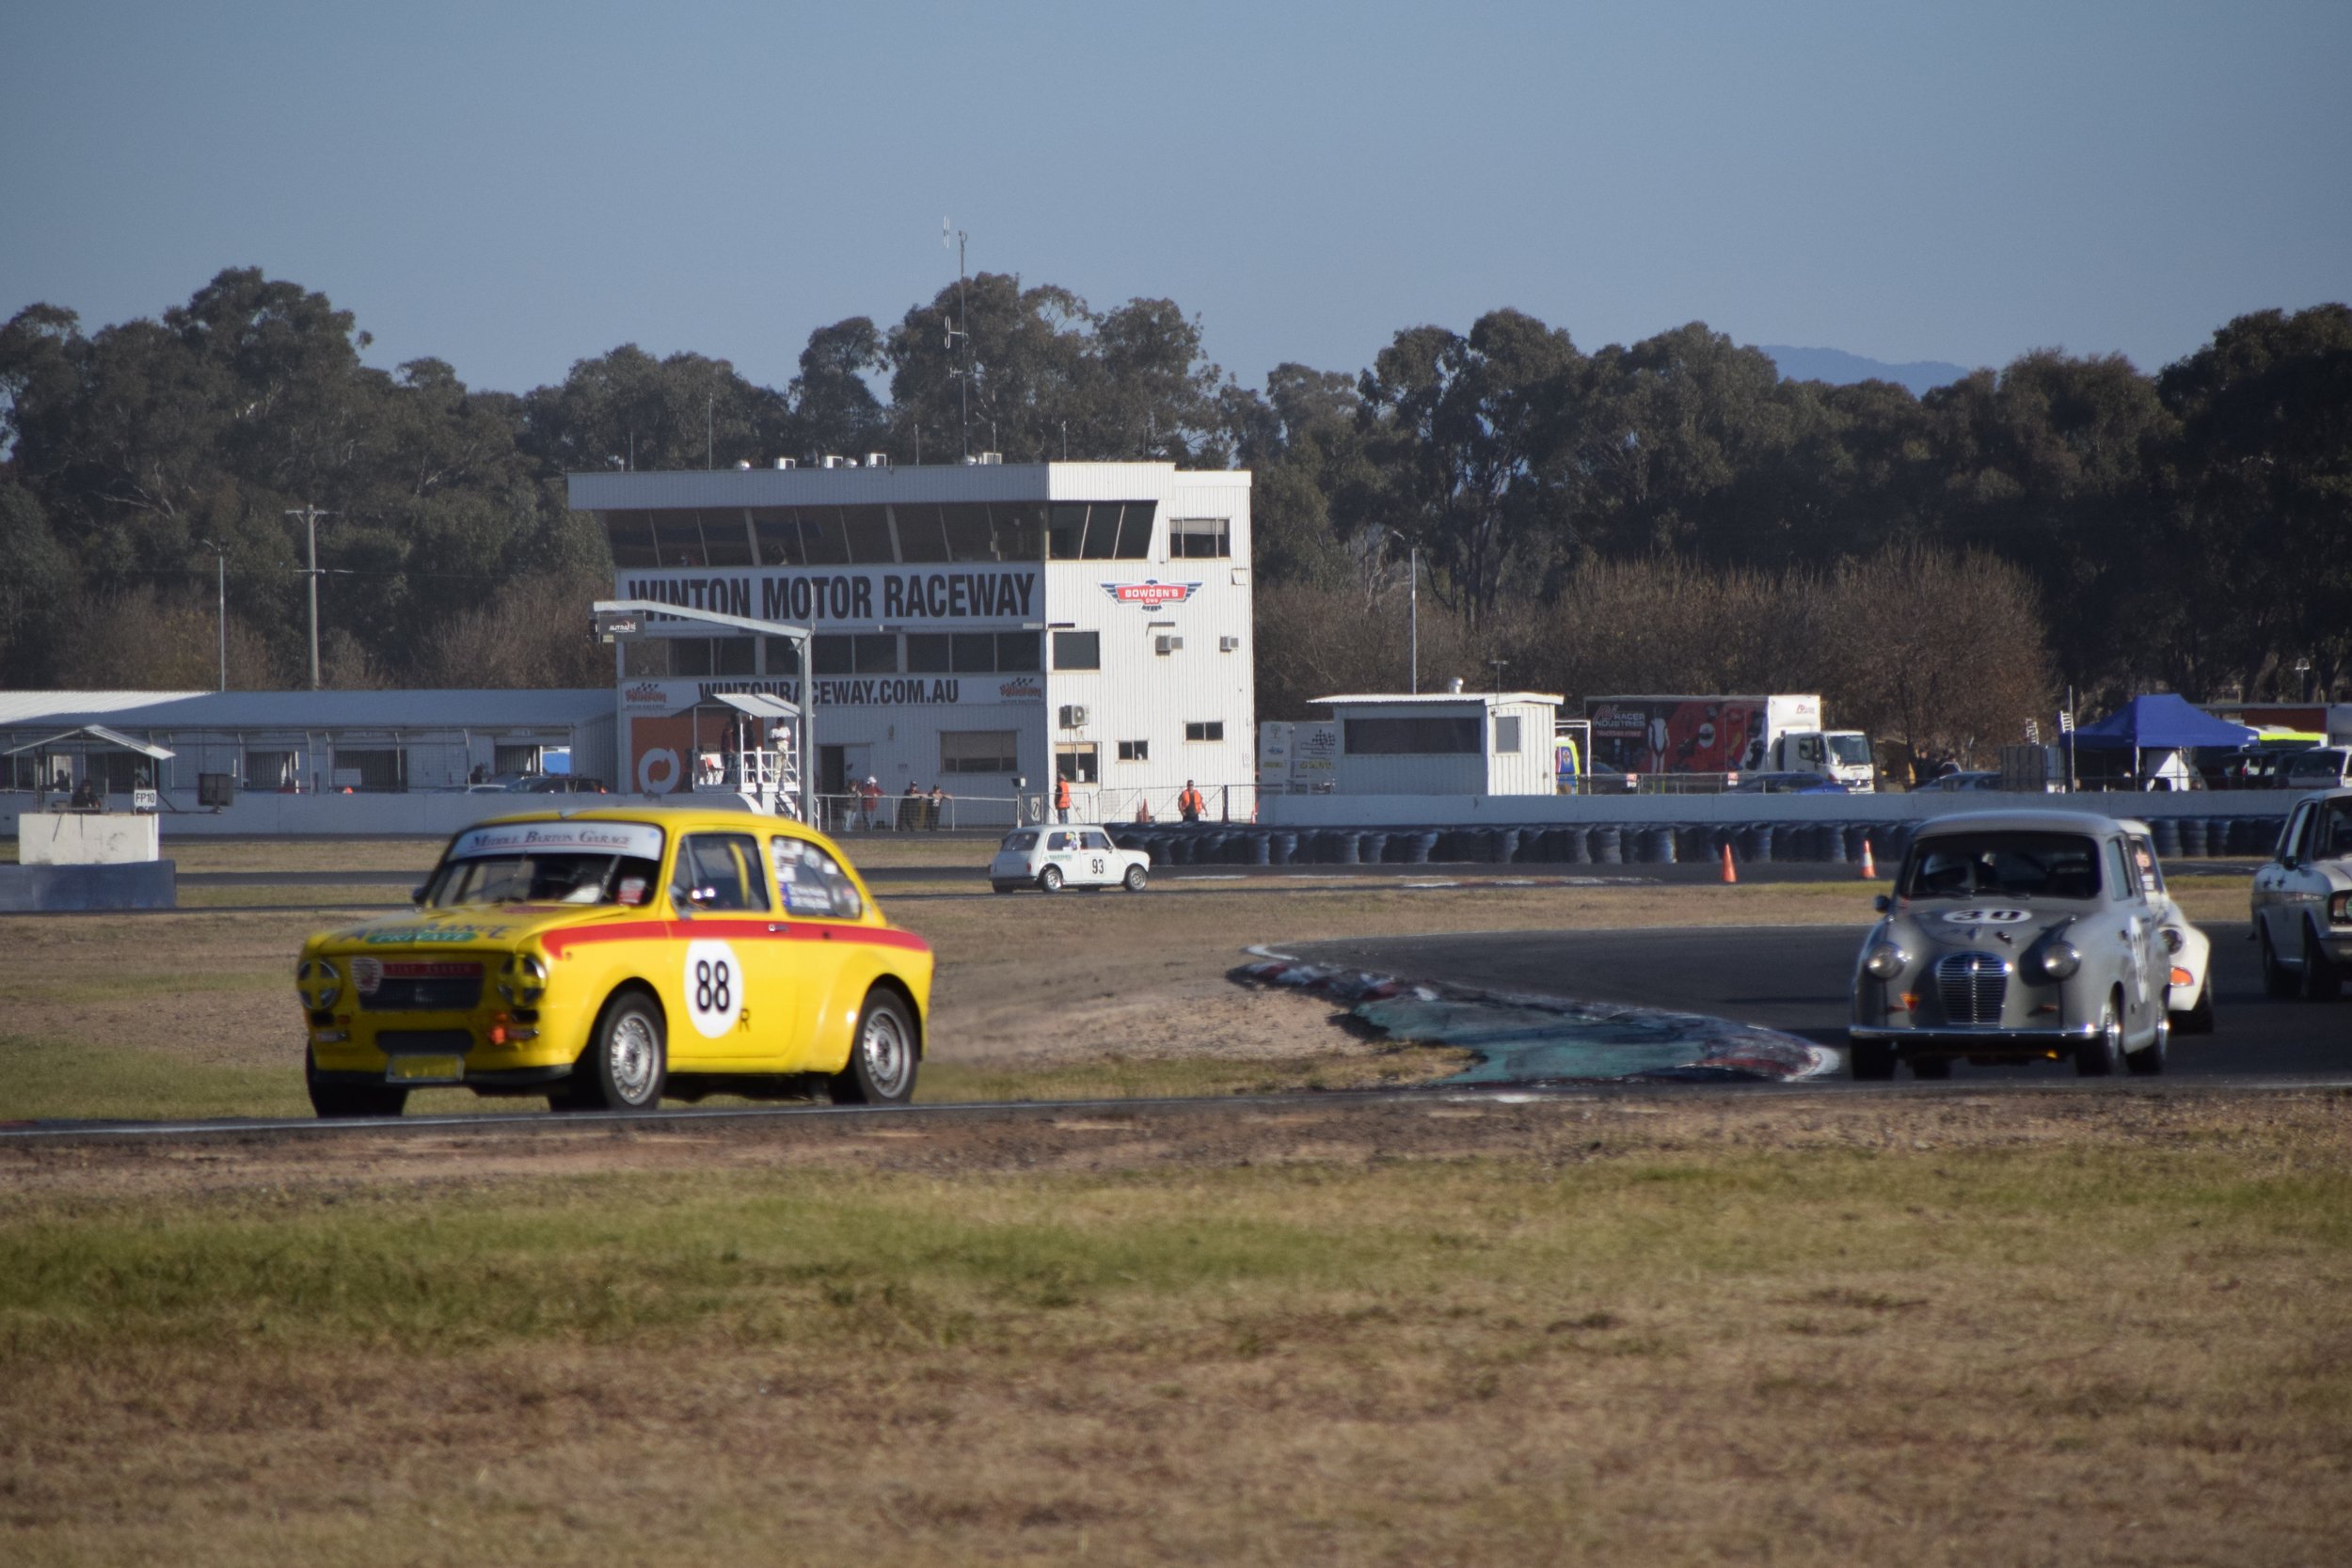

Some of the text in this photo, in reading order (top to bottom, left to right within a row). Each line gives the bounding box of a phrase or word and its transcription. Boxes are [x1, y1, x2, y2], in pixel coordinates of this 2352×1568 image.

[628, 572, 1036, 622] WINTON MOTOR RACEWAY
[1124, 588, 1179, 598] BOWDEN'S
[135, 792, 155, 803] FP10
[473, 830, 631, 847] MIDDLE BARTON GARAGE
[1091, 858, 1104, 875] 93
[1951, 911, 2022, 921] 30
[696, 959, 730, 1013] 88
[739, 1007, 751, 1032] R
